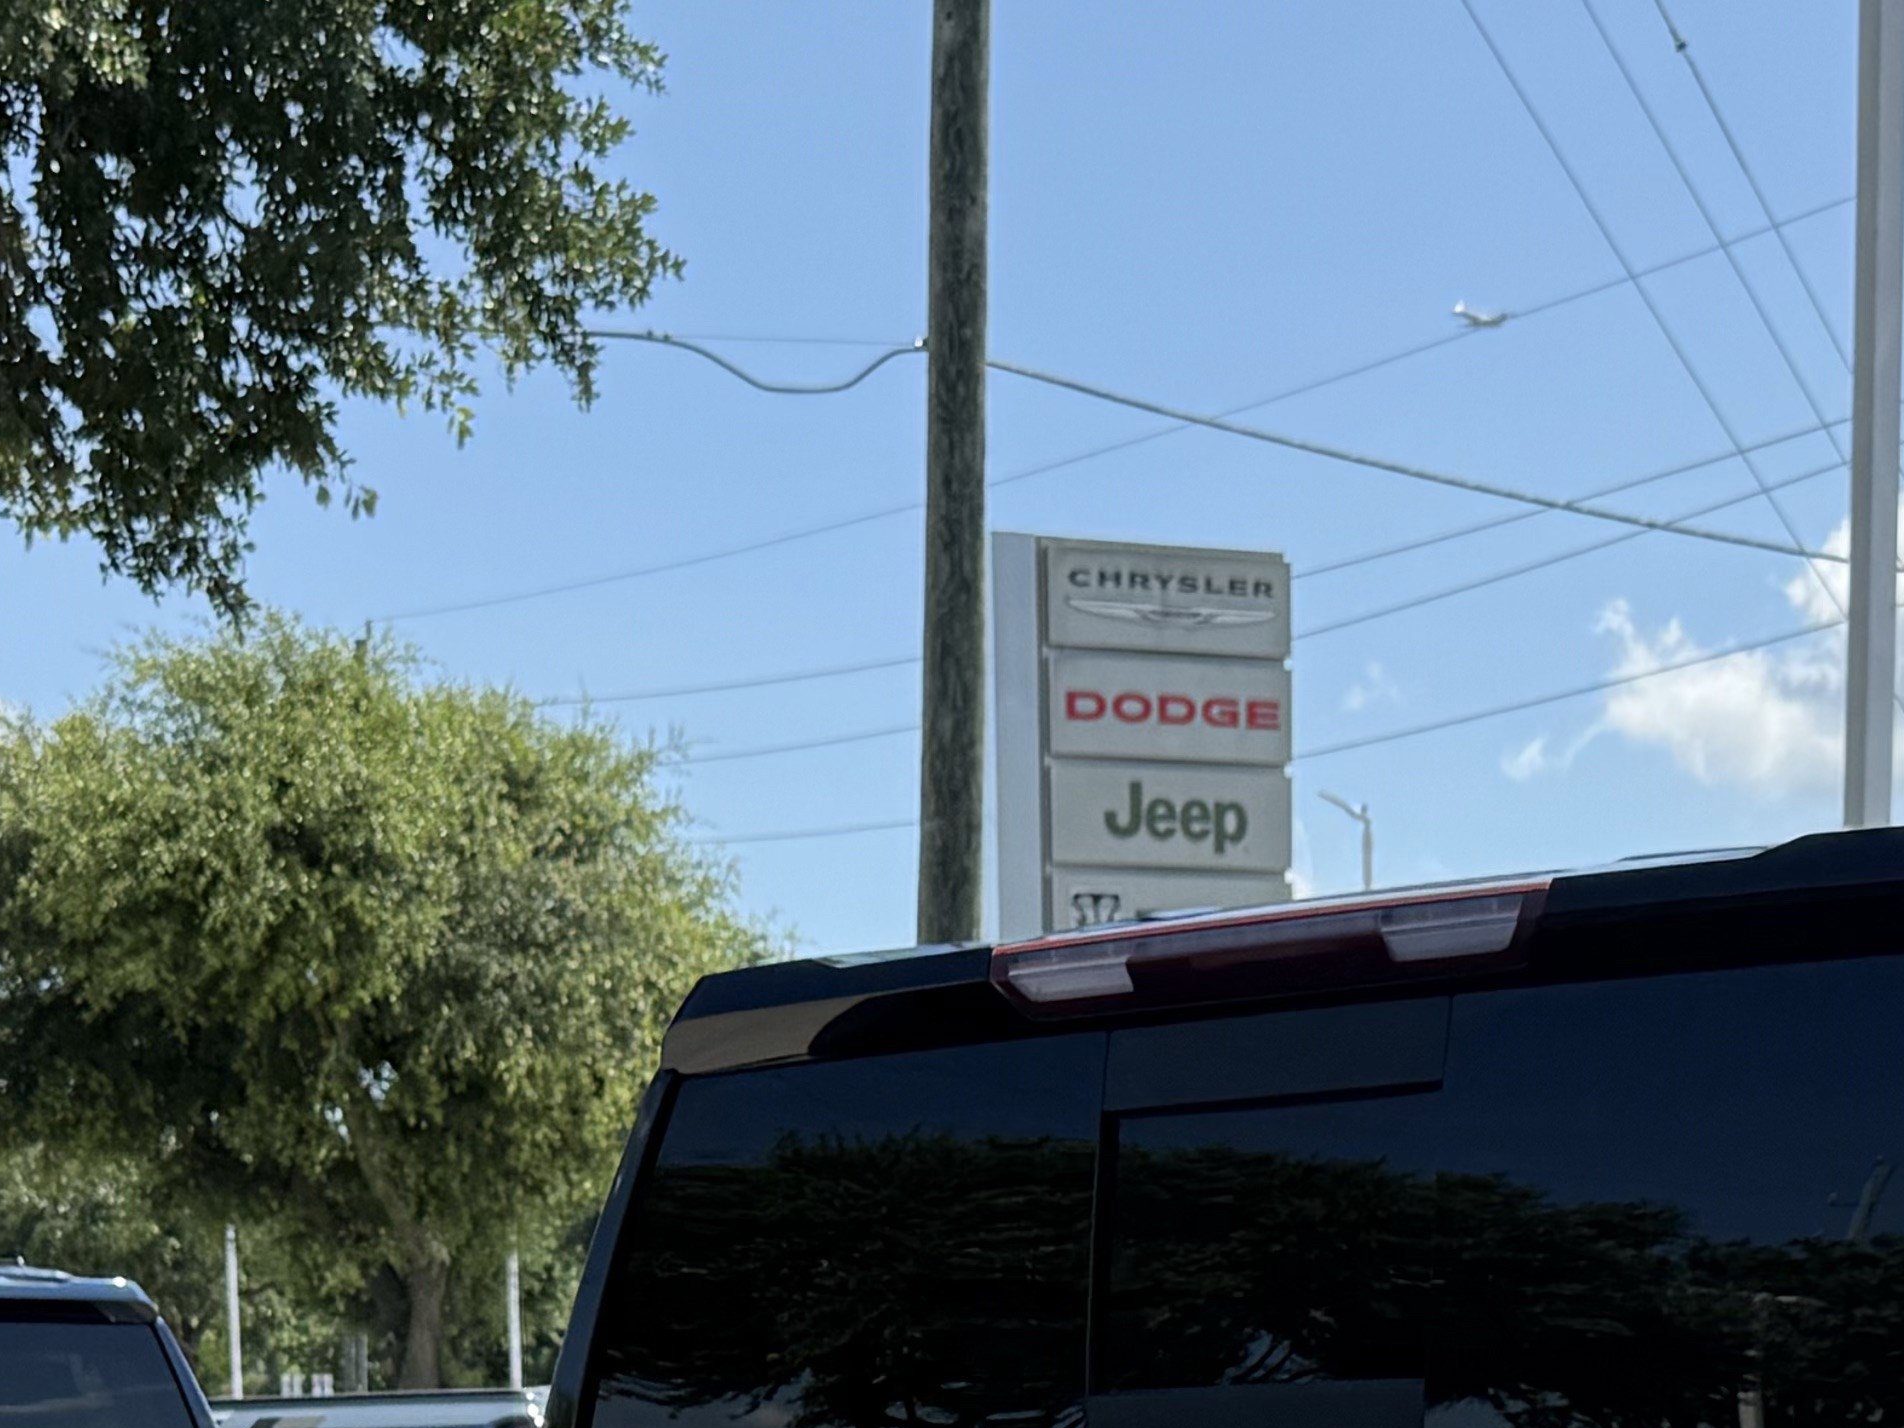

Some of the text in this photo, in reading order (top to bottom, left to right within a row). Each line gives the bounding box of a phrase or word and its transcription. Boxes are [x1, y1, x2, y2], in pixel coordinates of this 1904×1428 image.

[1068, 568, 1275, 599] CHRYSLER
[1065, 690, 1281, 731] DODGE
[1104, 780, 1249, 855] Jeep
